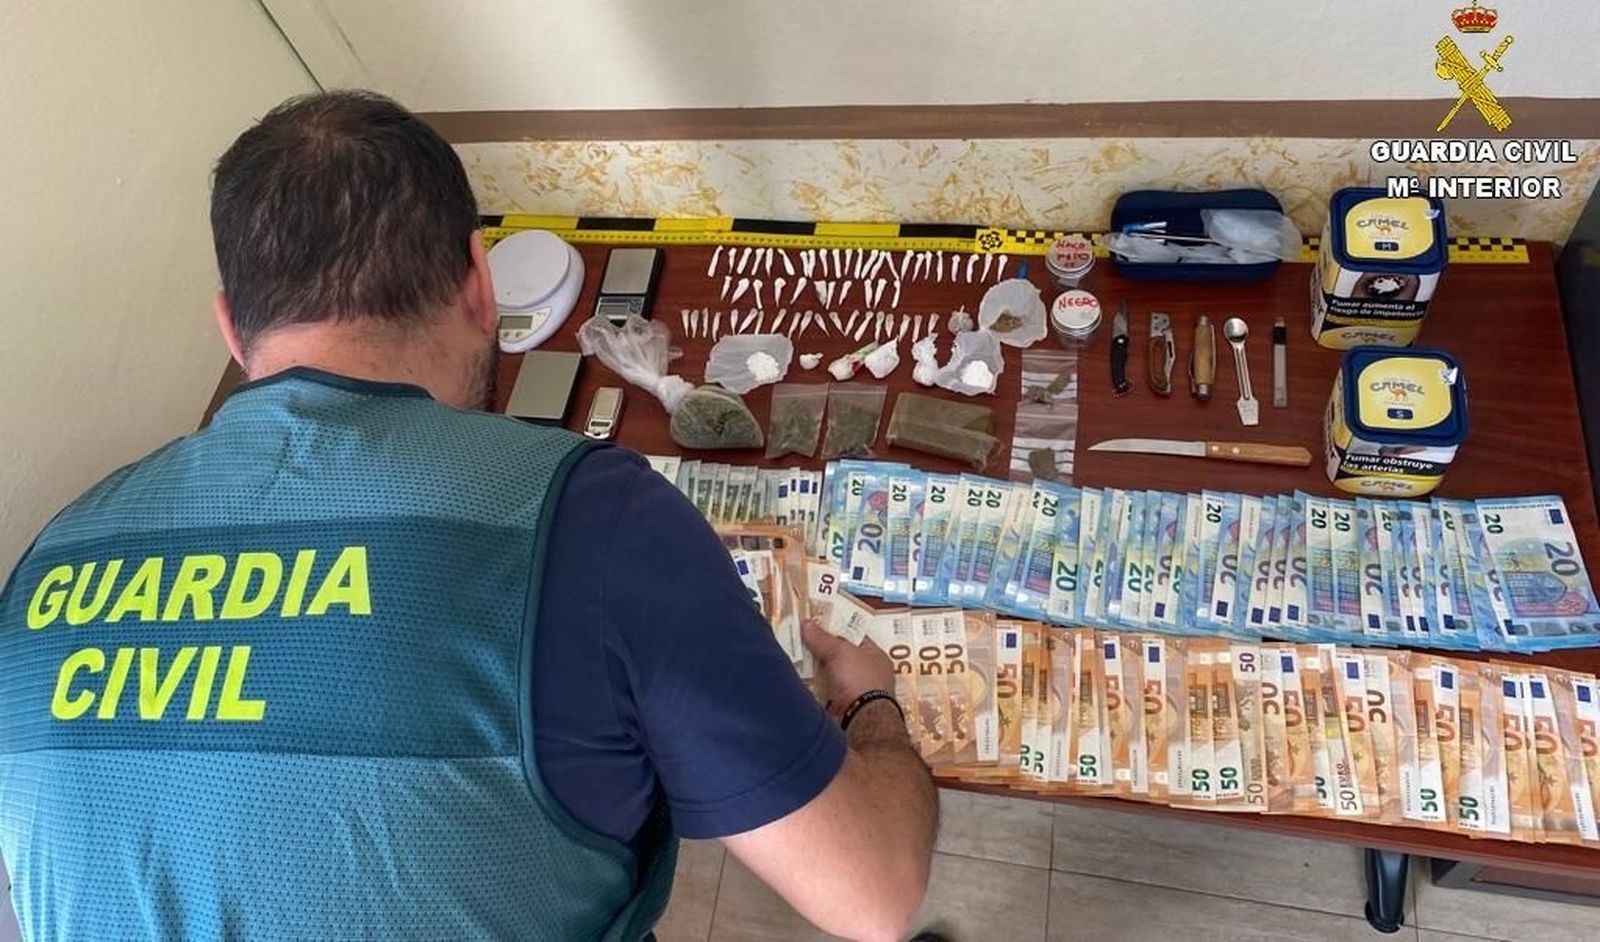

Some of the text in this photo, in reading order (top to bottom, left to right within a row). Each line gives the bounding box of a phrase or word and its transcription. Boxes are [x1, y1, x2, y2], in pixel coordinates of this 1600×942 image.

[1356, 218, 1409, 230] CAMEL
[1332, 300, 1415, 311] Fumar aumenta el
[1370, 382, 1425, 395] CAMEL
[1345, 454, 1434, 470] Fumar obstruye
[1361, 463, 1404, 474] arterias
[892, 484, 906, 502] 20
[931, 485, 945, 503] 20
[968, 488, 983, 507] 20
[985, 490, 1001, 508] 20
[1042, 498, 1058, 517] 20
[1206, 503, 1221, 523] 20
[1311, 508, 1327, 529] 20
[1334, 512, 1350, 532] 20
[1484, 514, 1504, 534] 20
[858, 523, 884, 555] 20
[1544, 541, 1580, 576] 20
[818, 573, 835, 595] 50
[1056, 561, 1078, 592] 20
[26, 546, 372, 630] GUARDIA
[919, 646, 942, 675] 50
[945, 644, 965, 674] 50
[1239, 652, 1255, 673] 50
[51, 646, 267, 720] CIVIL
[1079, 754, 1097, 777] 50
[1192, 769, 1210, 792] 50
[1220, 767, 1238, 790] 50
[1247, 783, 1264, 803] 50
[1340, 790, 1357, 810] 50
[1421, 788, 1438, 813] 50
[1459, 796, 1479, 821] 50
